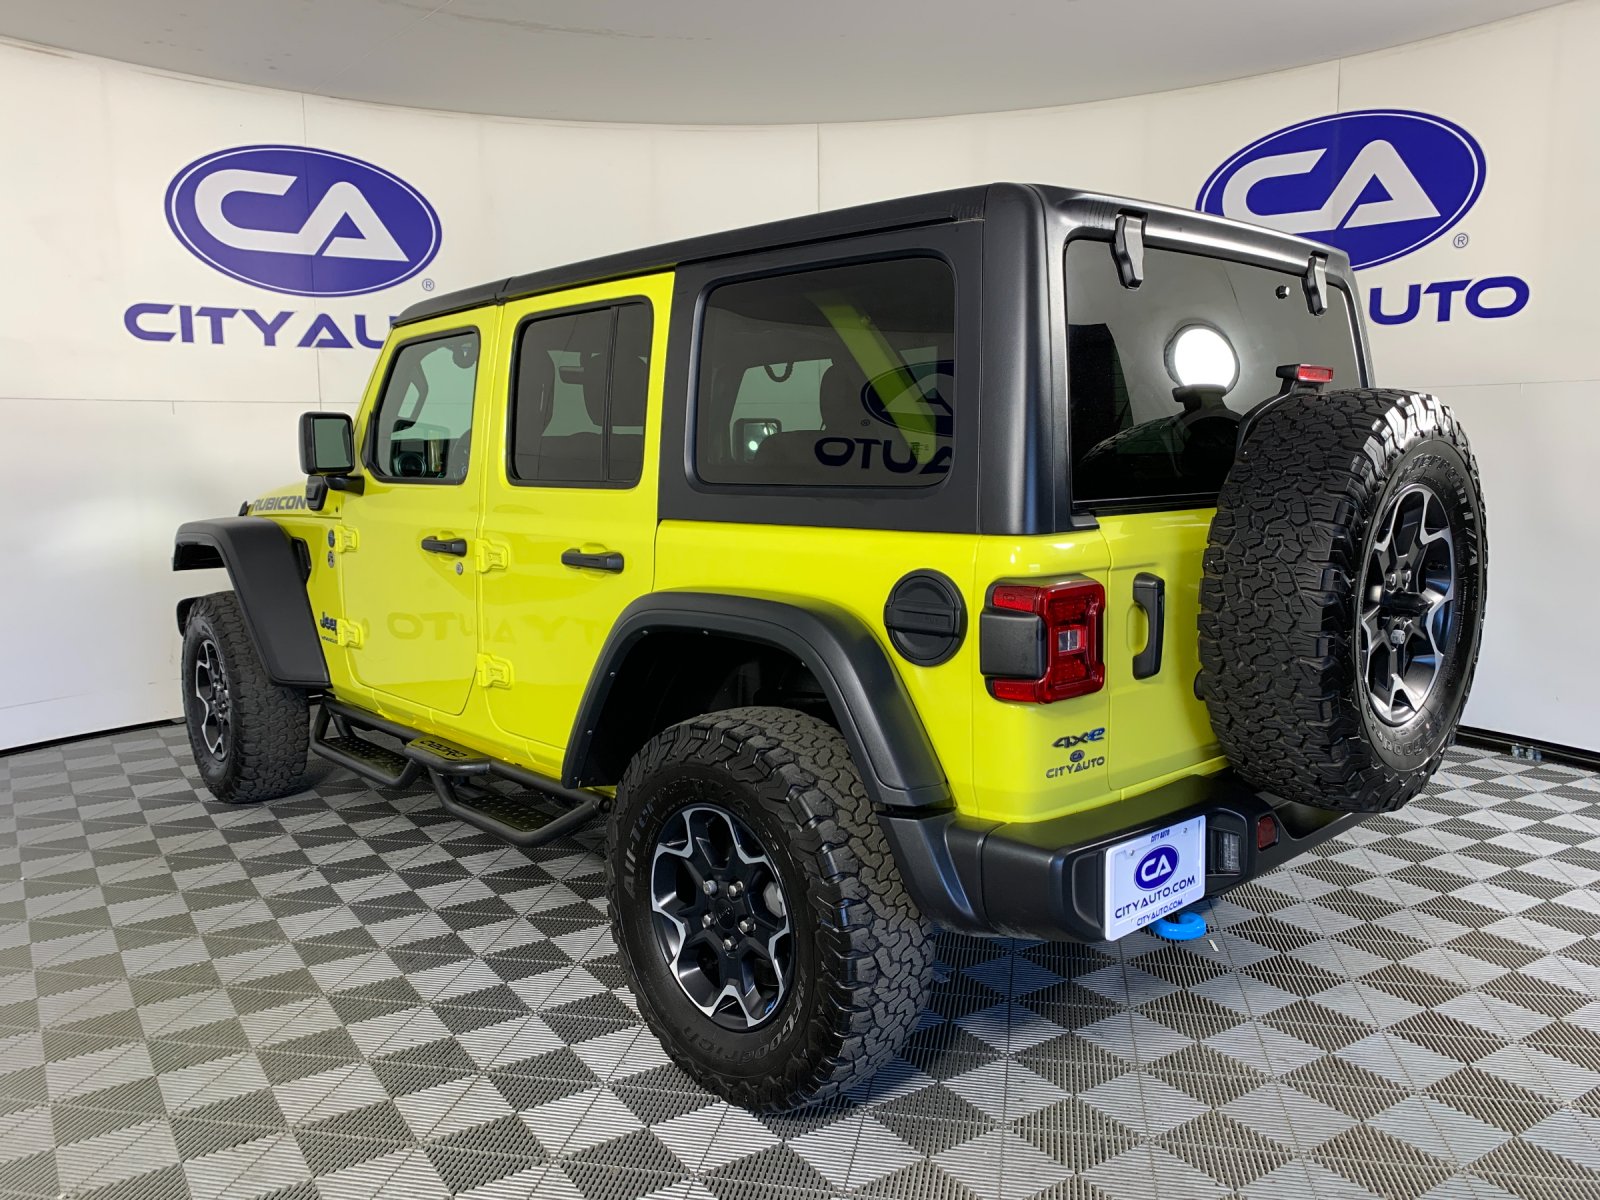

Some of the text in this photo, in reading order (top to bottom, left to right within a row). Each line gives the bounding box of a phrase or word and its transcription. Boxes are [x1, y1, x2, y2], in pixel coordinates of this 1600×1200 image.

[1222, 139, 1441, 235] CA
[194, 168, 410, 262] CA
[1369, 275, 1530, 325] UTO
[124, 302, 398, 349] CITYAU
[254, 495, 306, 512] RUBICON
[1151, 829, 1170, 843] CITY AUTO
[1141, 854, 1172, 882] CA
[1115, 875, 1196, 919] CITYAUTO.COM
[1136, 898, 1183, 926] CITYAUTO.COM
